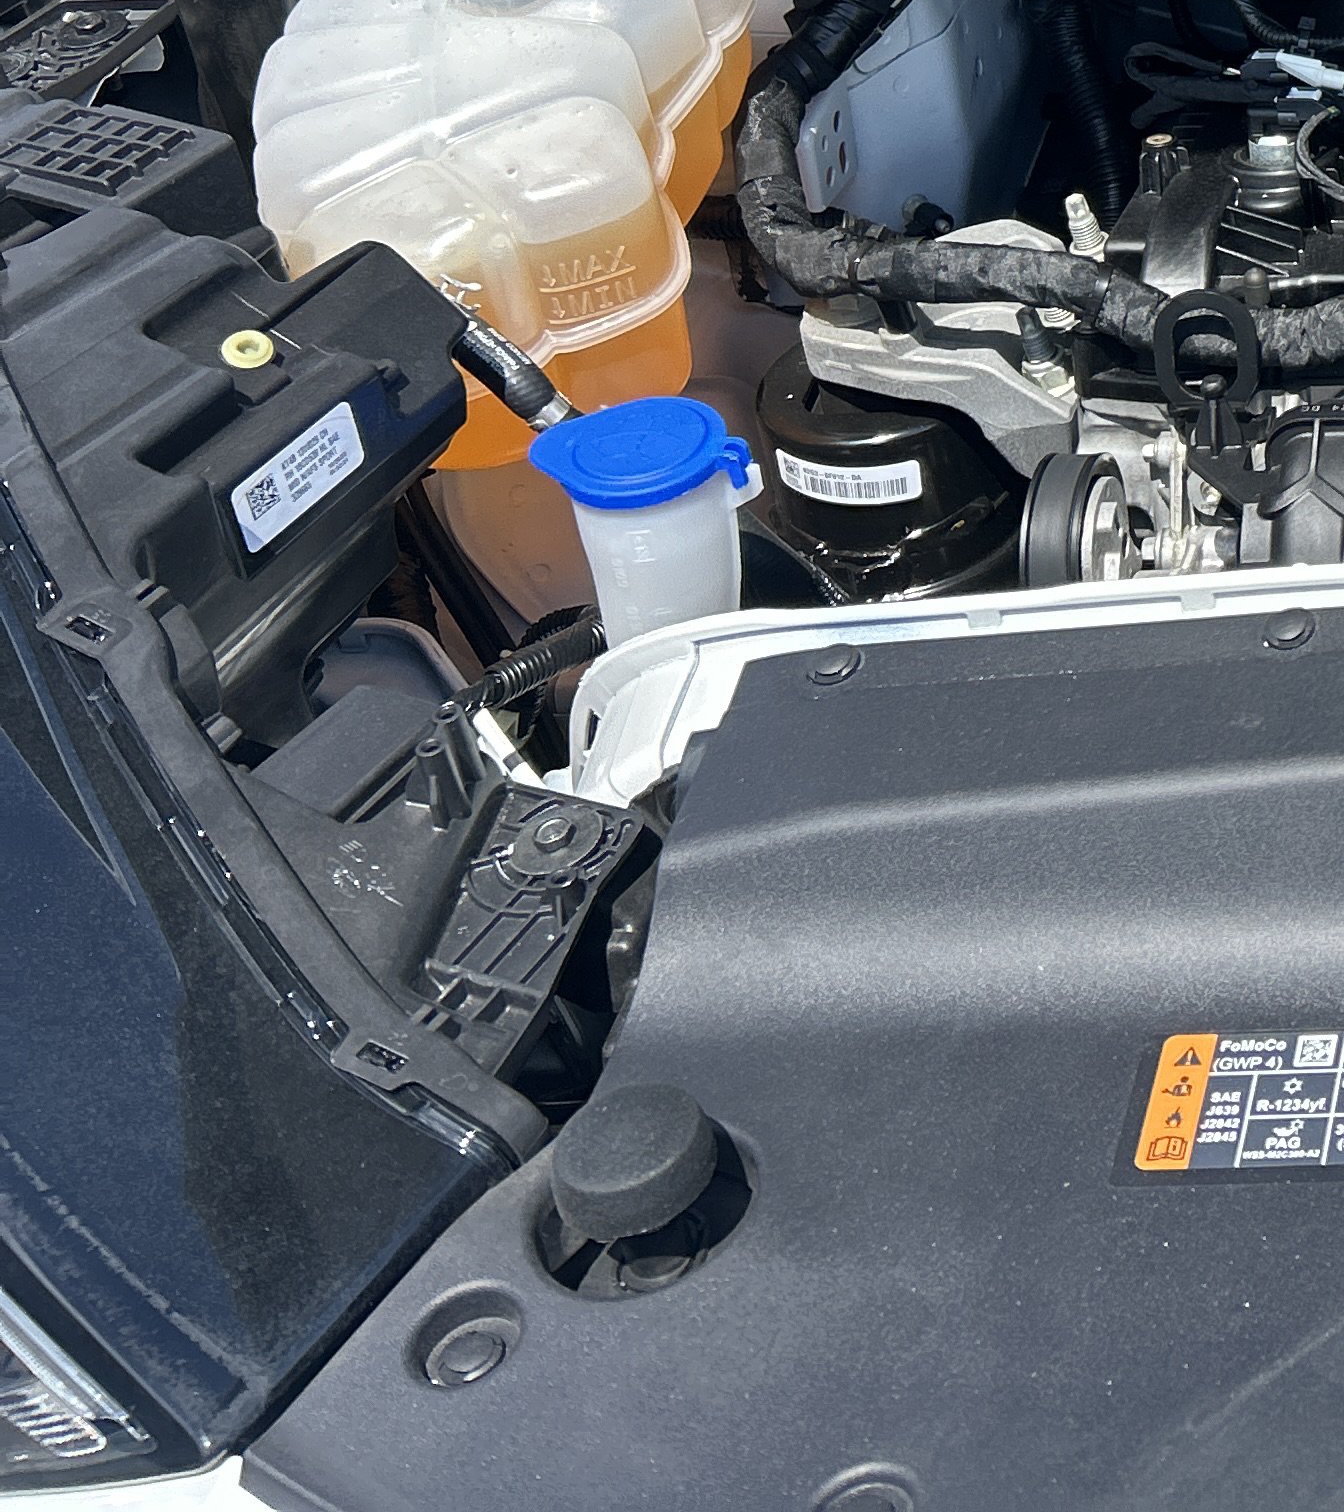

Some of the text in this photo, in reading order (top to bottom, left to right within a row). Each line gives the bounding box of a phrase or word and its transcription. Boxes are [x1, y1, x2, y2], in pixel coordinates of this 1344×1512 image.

[1219, 1038, 1287, 1052] FoMoCo
[1213, 1056, 1283, 1072] (GWP 4)
[1210, 1091, 1241, 1103] SAE
[1265, 1137, 1301, 1149] PAG
